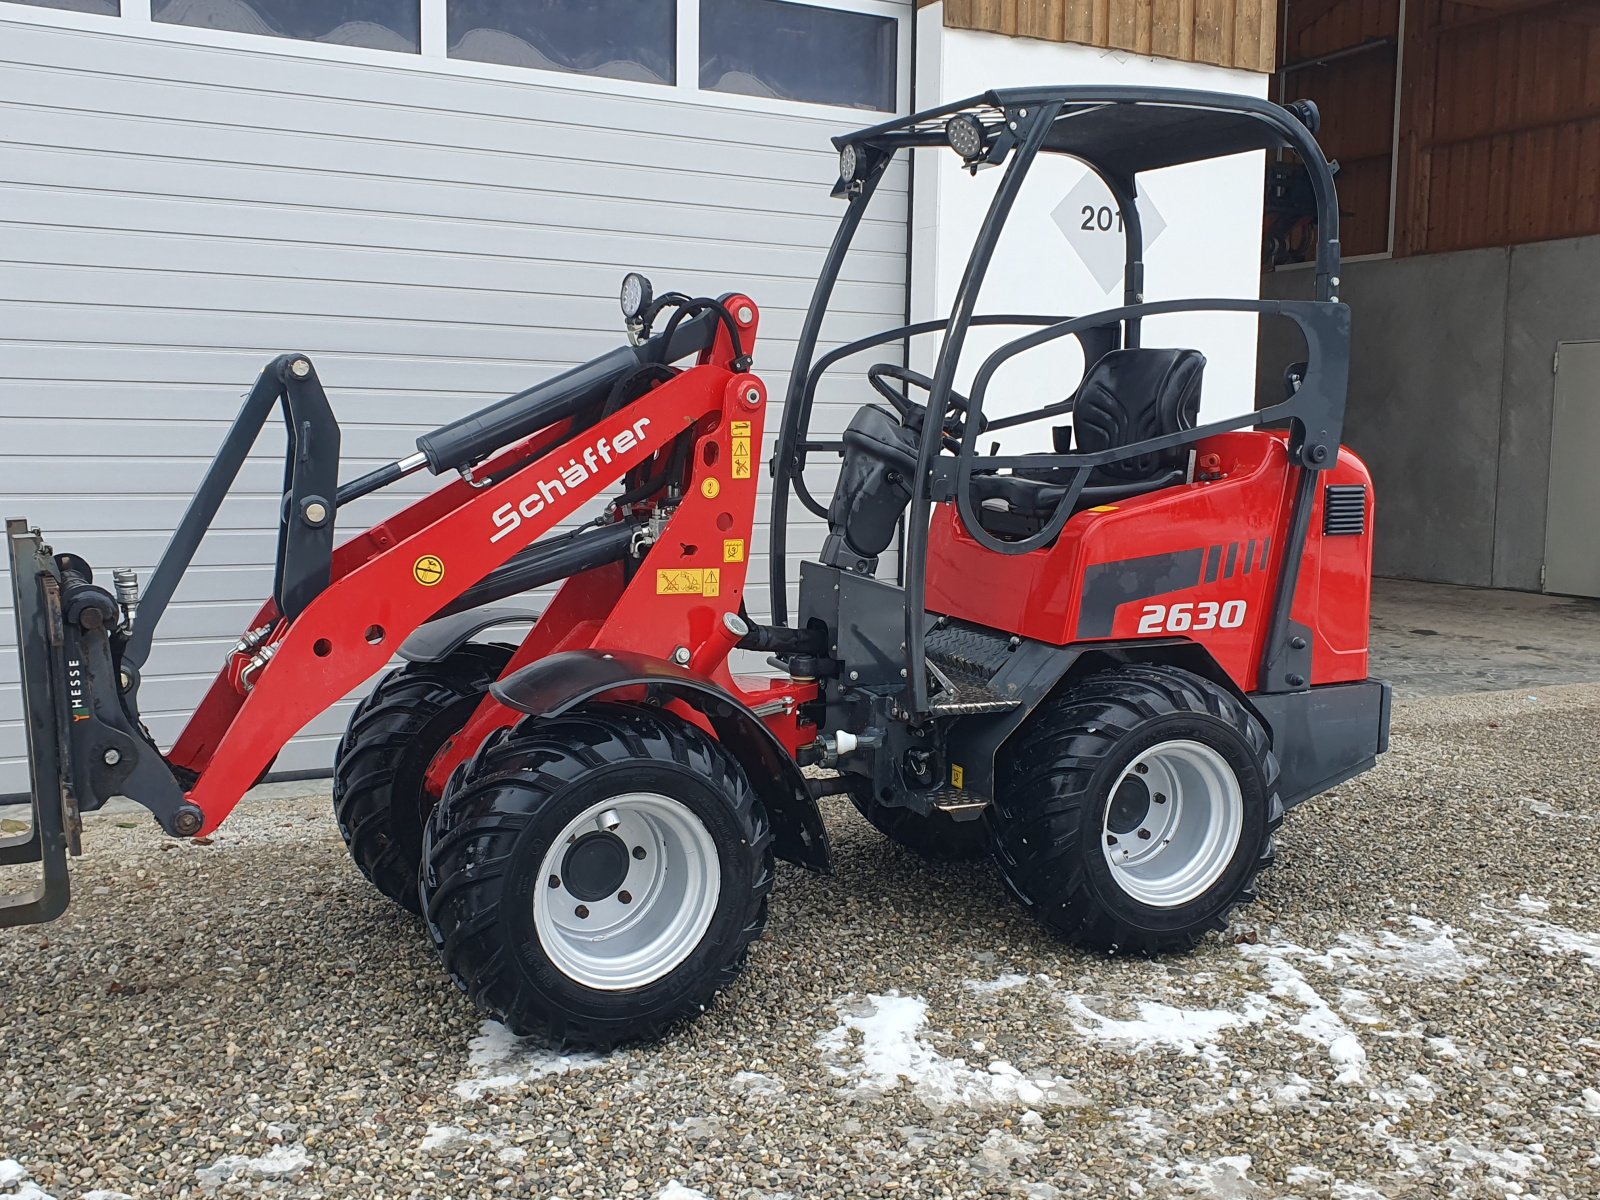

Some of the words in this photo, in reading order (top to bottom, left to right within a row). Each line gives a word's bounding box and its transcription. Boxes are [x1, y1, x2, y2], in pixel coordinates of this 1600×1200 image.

[1080, 205, 1123, 233] 201
[489, 417, 651, 544] Schäffer
[1137, 599, 1247, 634] 2630
[68, 659, 83, 709] HESSE
